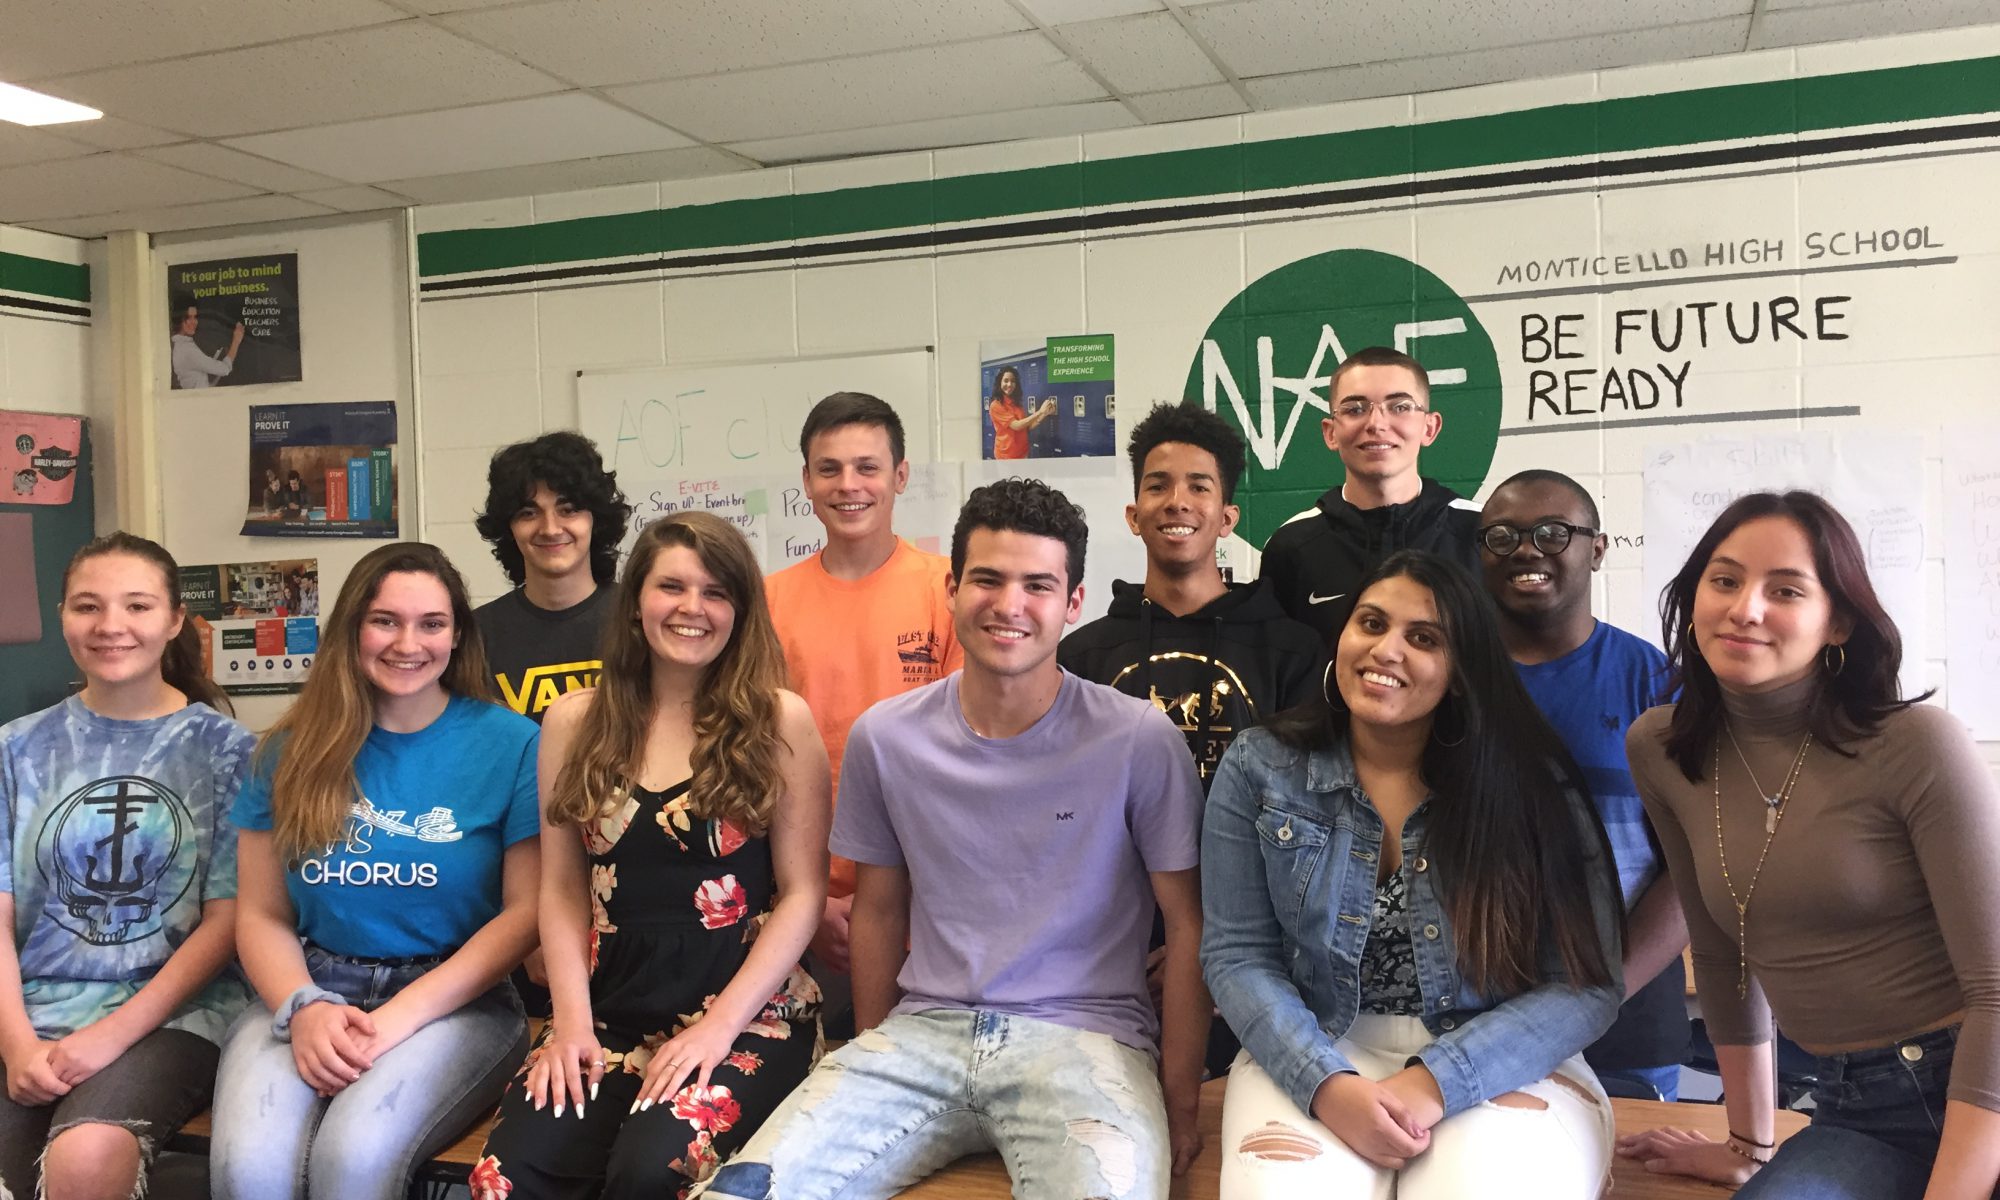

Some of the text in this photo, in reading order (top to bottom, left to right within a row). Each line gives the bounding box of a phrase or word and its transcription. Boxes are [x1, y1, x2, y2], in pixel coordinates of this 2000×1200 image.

[1497, 226, 1945, 285] MONTICELLO HIGH SCHOOL
[181, 263, 282, 284] It's our job to mind
[193, 282, 270, 300] your business.
[1520, 295, 1852, 363] BE FUTURE
[1053, 344, 1105, 353] TRANSFORMING
[1067, 356, 1083, 364] HIGH
[1084, 355, 1111, 363] SCHOOL
[1053, 367, 1095, 376] EXPERIENCE
[1528, 361, 1691, 420] READY
[255, 420, 291, 430] PROVE IT
[614, 389, 814, 468] AOF clu
[782, 487, 816, 518] Pro
[180, 590, 215, 600] PROVE IT
[494, 659, 603, 715] VAN
[1056, 811, 1075, 821] MK
[301, 858, 438, 888] CHORUS
